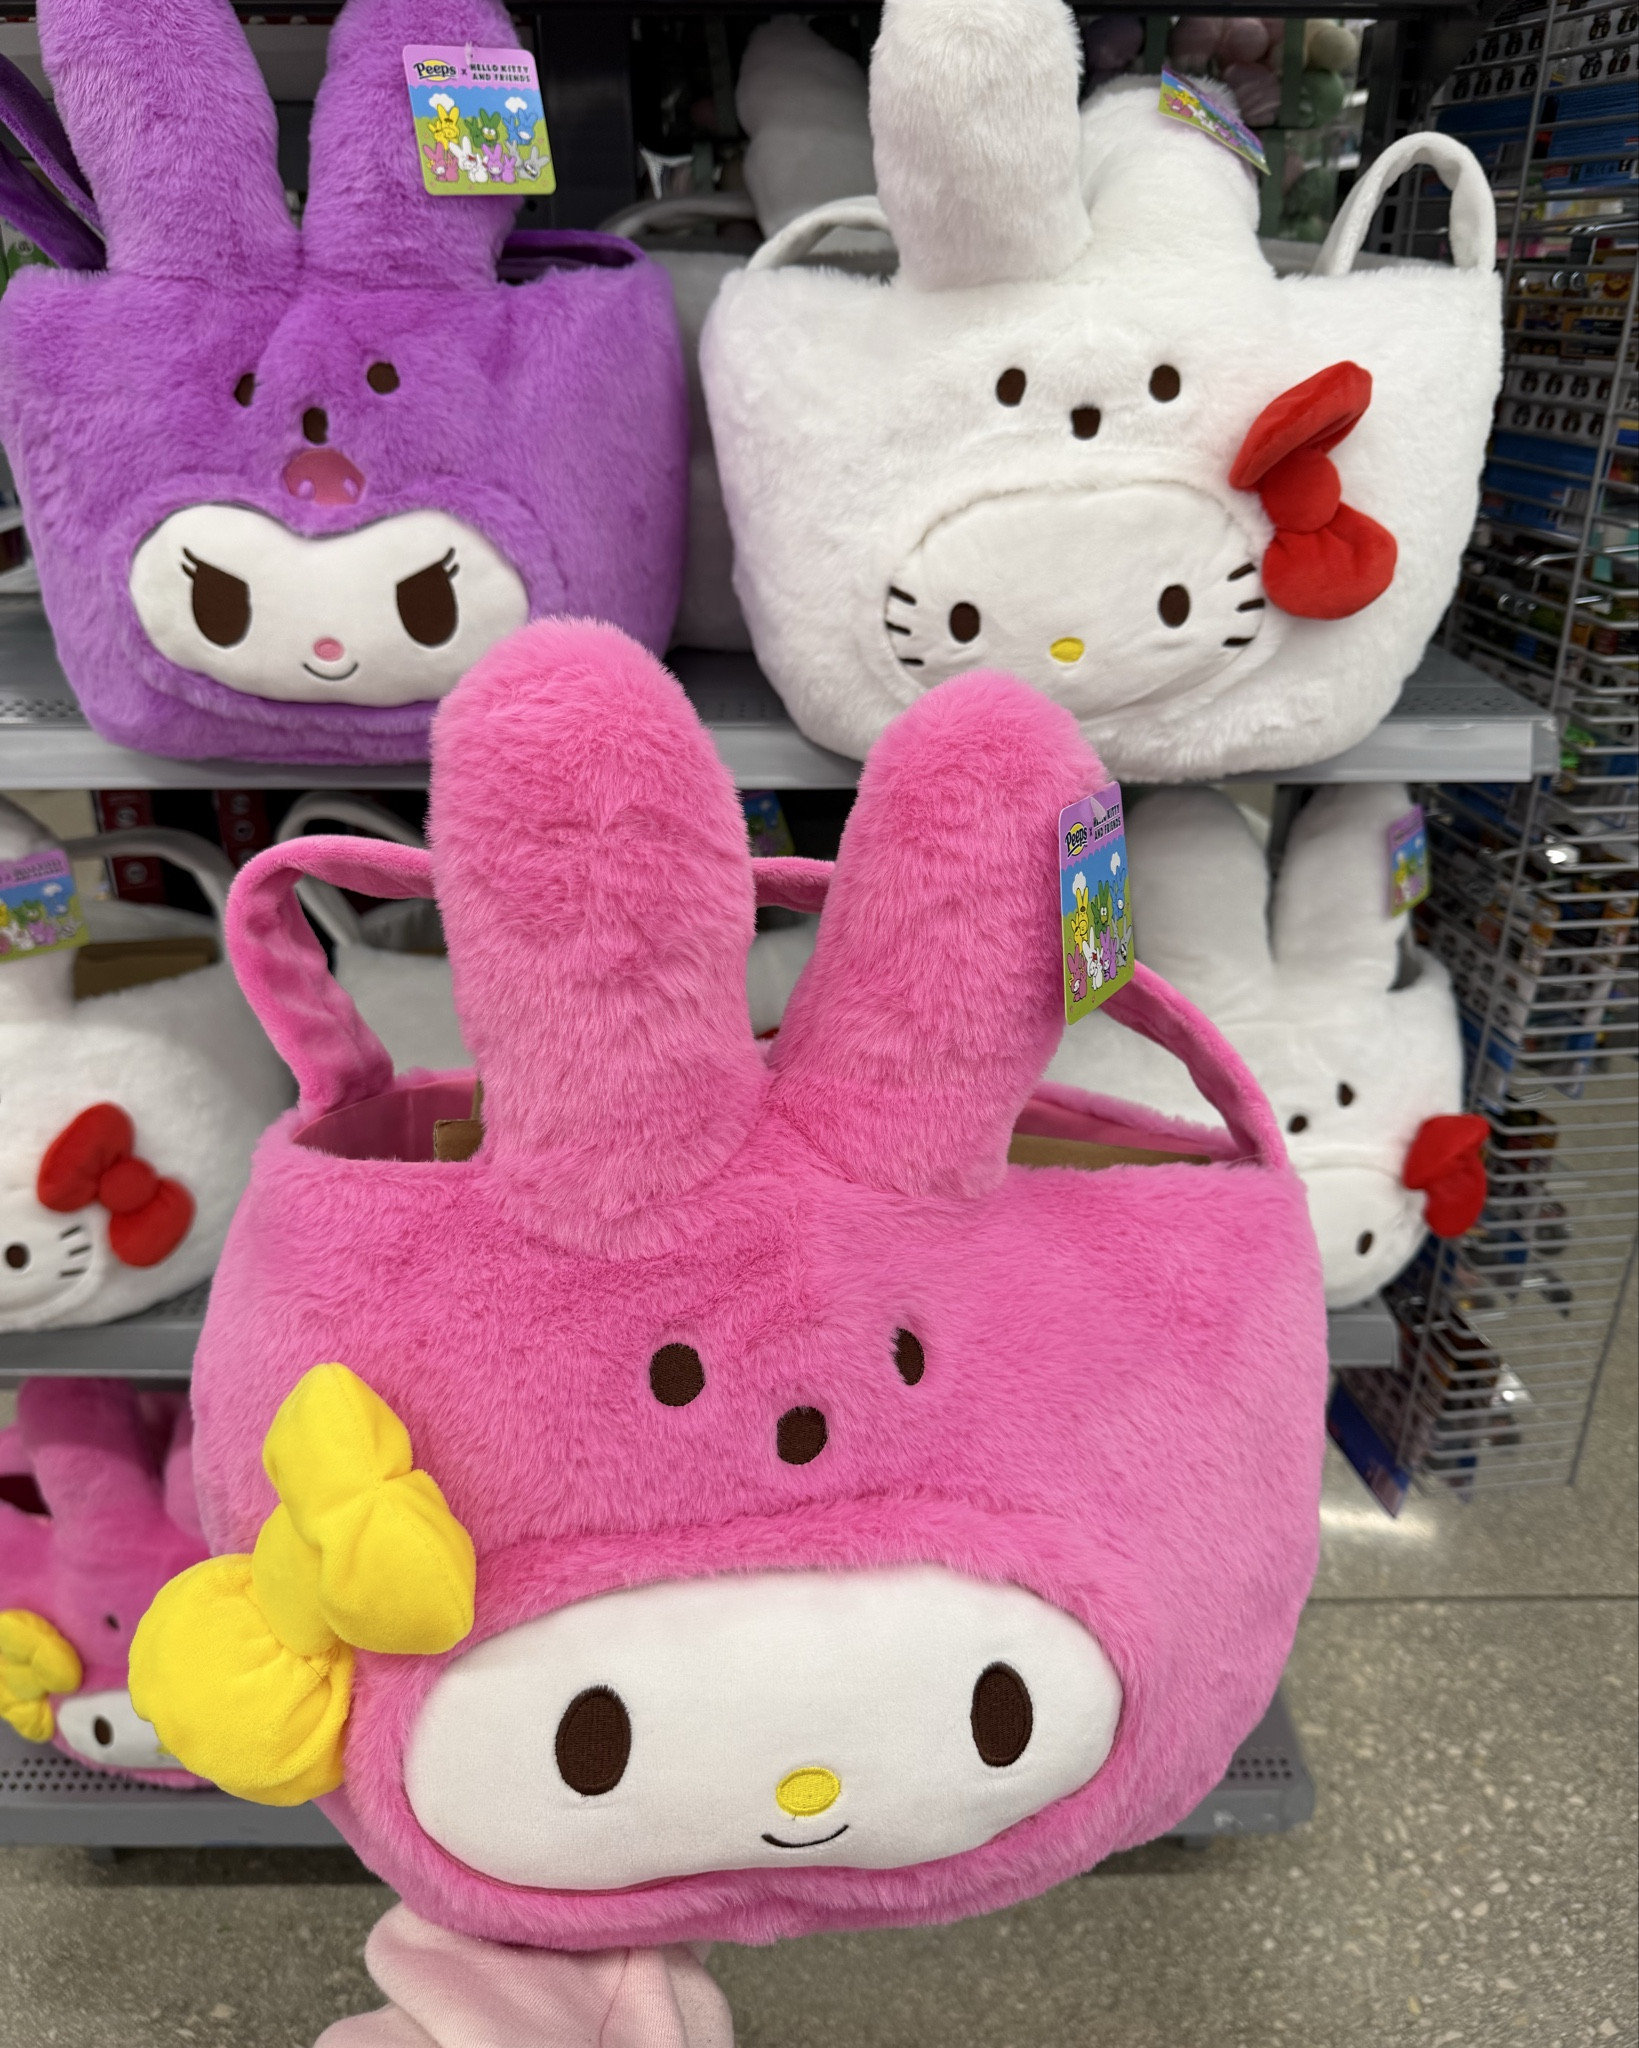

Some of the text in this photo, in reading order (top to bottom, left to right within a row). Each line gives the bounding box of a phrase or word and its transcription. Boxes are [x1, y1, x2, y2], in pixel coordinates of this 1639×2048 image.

[413, 62, 456, 78] Peeps
[470, 64, 529, 73] HELLO KITTY
[473, 73, 531, 82] AND FRIENDS
[1106, 804, 1119, 818] KITTY
[1094, 827, 1103, 841] AND
[1104, 817, 1121, 835] FRIENDS
[1065, 827, 1087, 853] Peeps
